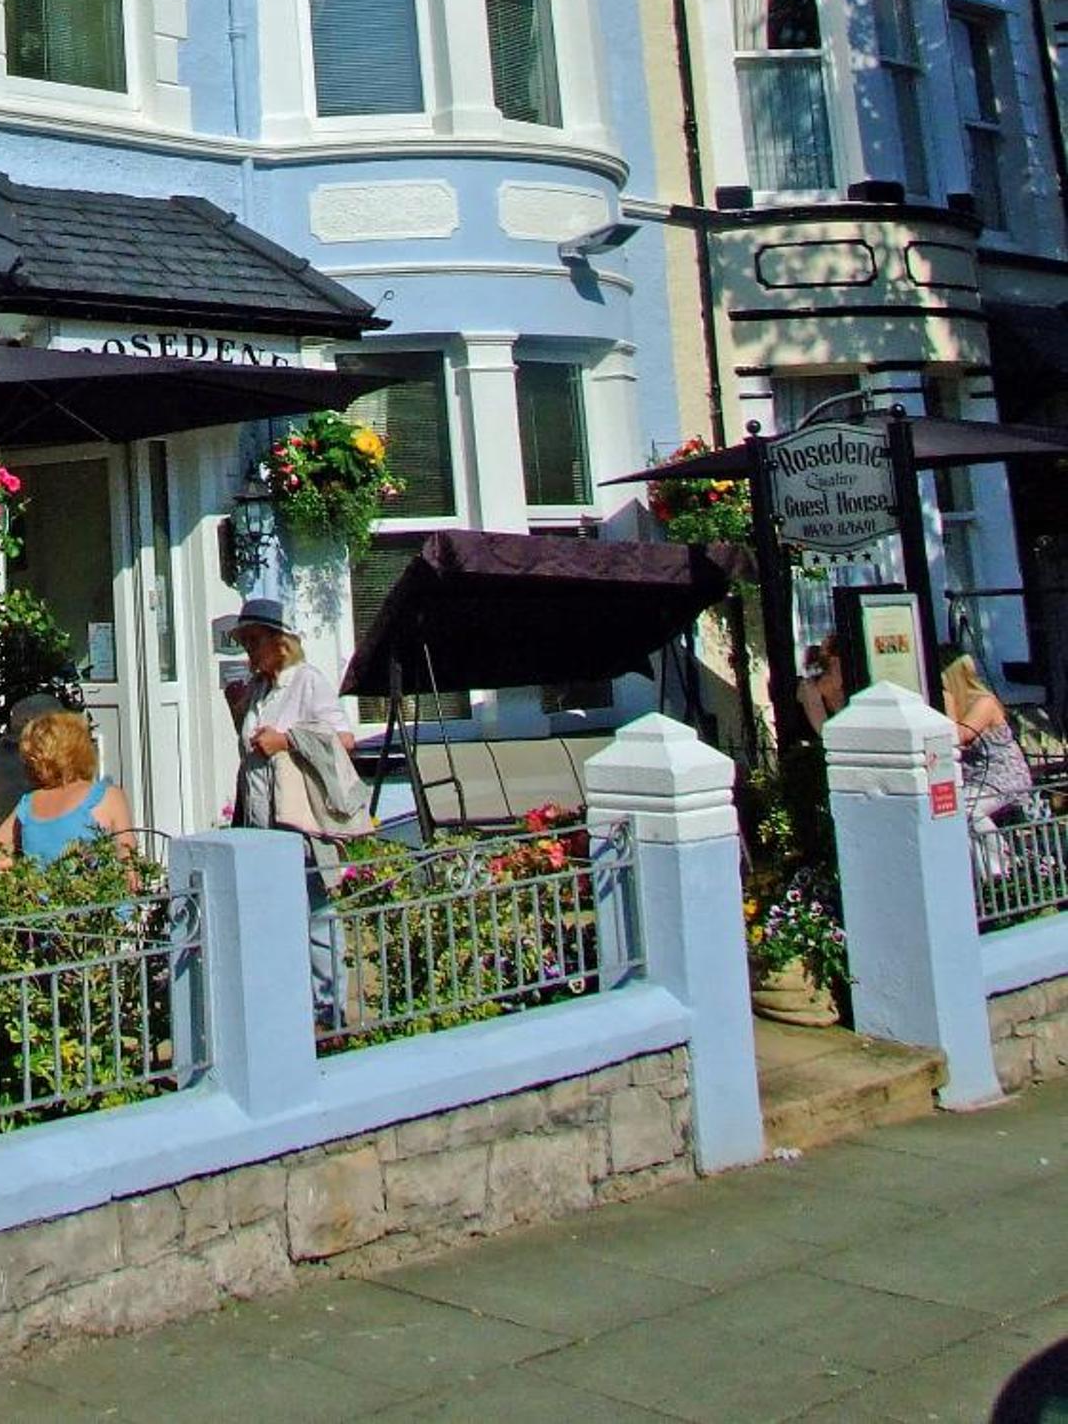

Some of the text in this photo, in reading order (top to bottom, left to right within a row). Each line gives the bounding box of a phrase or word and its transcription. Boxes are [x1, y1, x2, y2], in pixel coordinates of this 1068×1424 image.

[777, 433, 882, 477] Rosedene
[784, 491, 888, 519] Guest House
